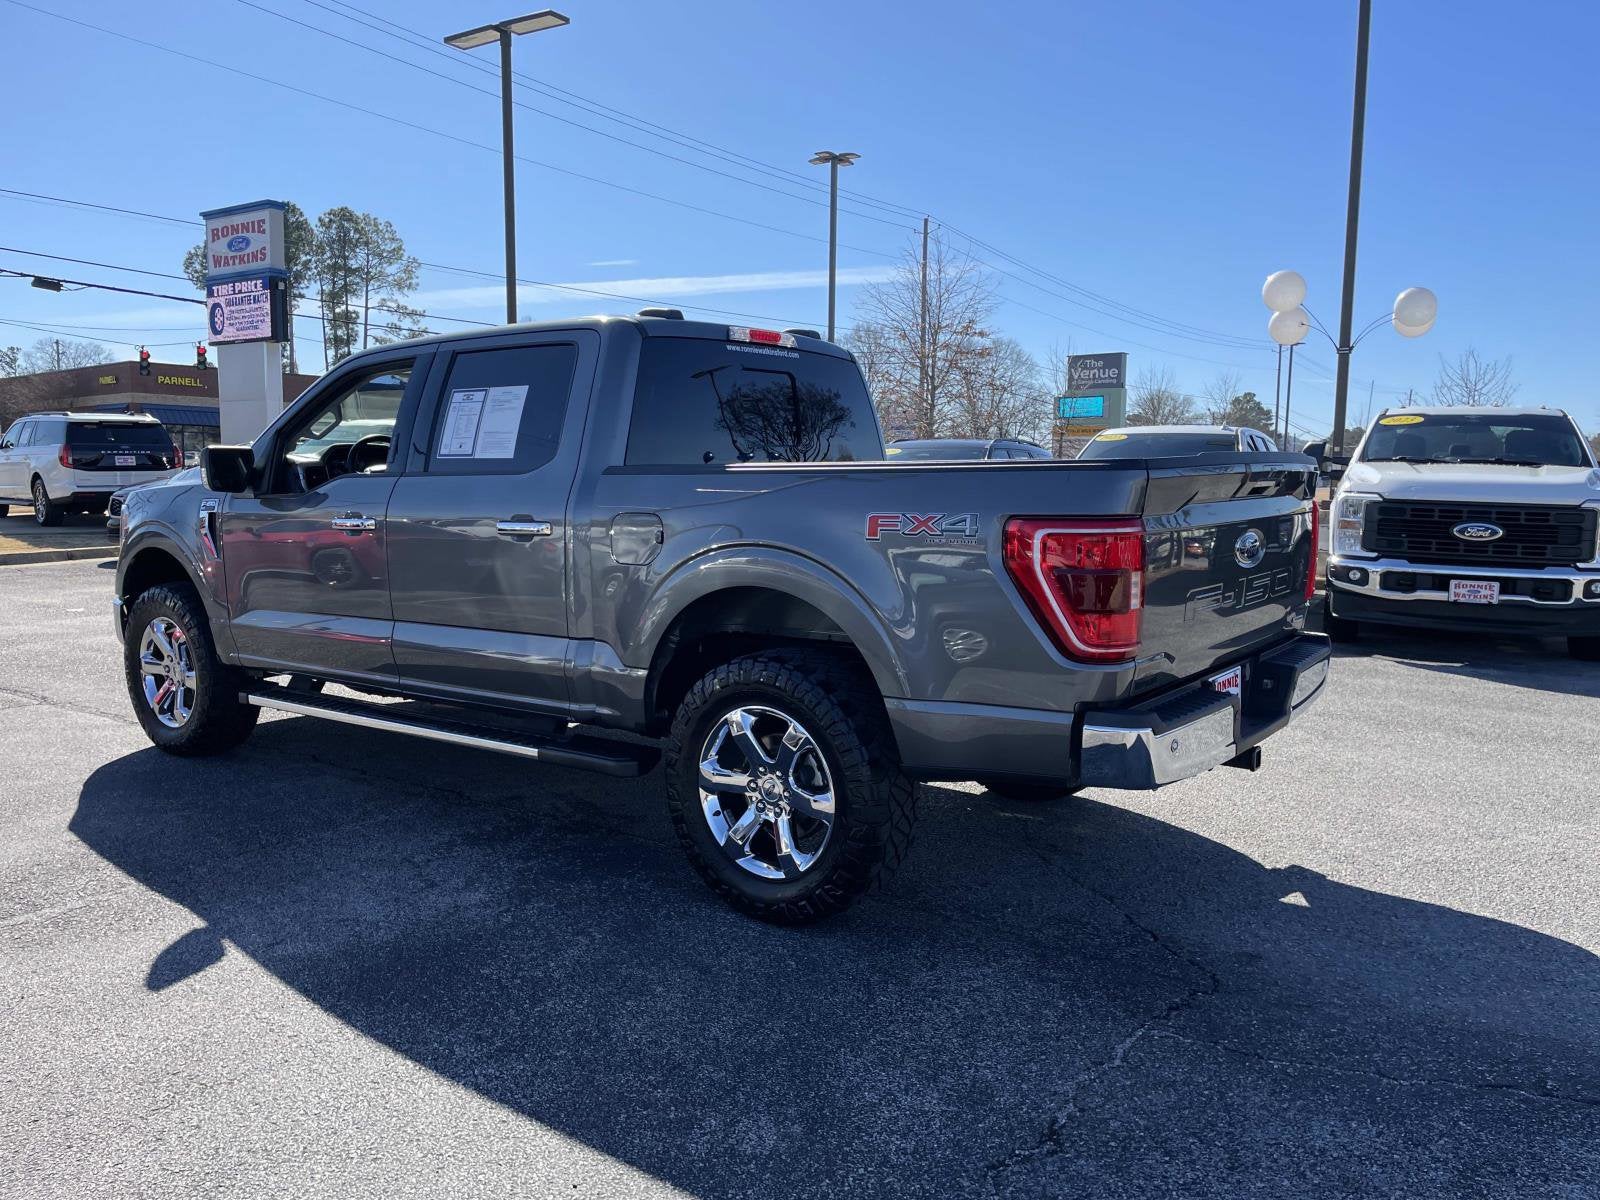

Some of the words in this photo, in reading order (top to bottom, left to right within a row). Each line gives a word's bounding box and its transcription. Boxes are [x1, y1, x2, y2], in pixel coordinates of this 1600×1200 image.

[211, 218, 266, 243] RONNIE
[212, 246, 267, 268] WATKINS
[212, 284, 234, 297] TIRE
[235, 280, 262, 295] PRICE
[1085, 359, 1104, 368] The
[1071, 368, 1118, 379] Venue
[157, 376, 203, 386] PARNELL
[865, 512, 980, 542] FX4
[1464, 526, 1492, 537] Ford
[1454, 582, 1496, 591] RONNIE
[1183, 566, 1294, 622] F-150
[1453, 591, 1496, 601] WATKINS
[1216, 673, 1239, 691] ONNIE
